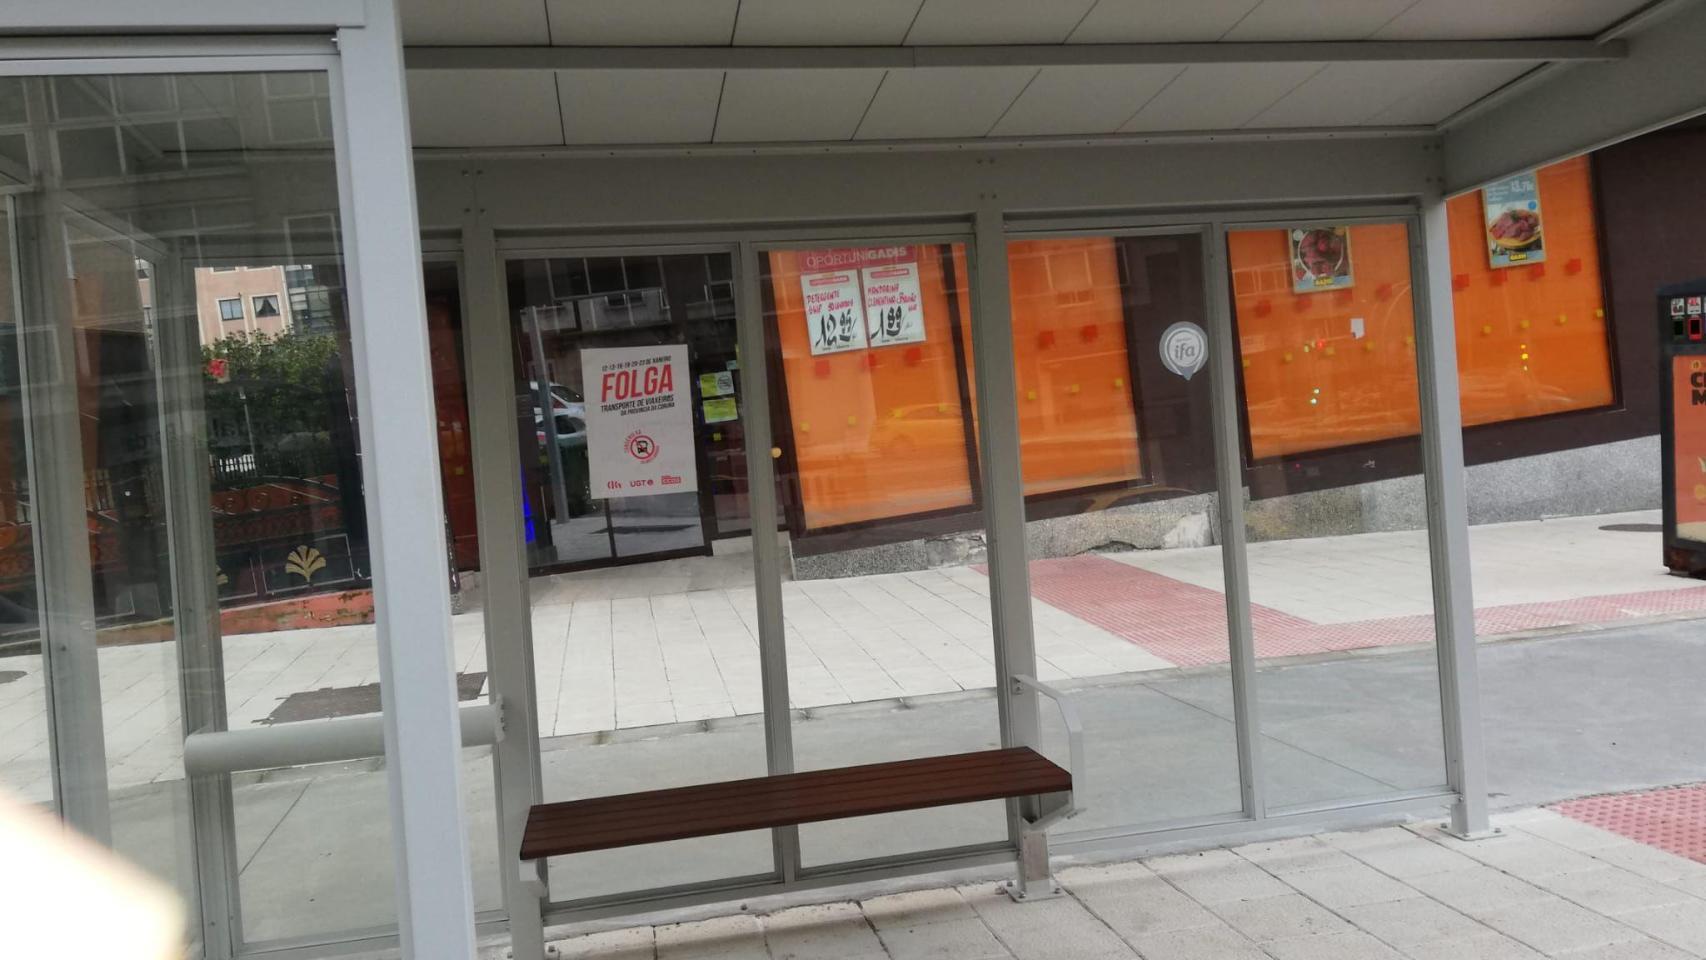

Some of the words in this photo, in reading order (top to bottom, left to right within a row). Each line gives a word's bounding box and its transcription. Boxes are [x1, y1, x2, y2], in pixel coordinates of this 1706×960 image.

[806, 248, 907, 268] OPORTUNIGADIS
[1174, 342, 1196, 361] ifa
[601, 363, 674, 403] FOLGA
[600, 399, 635, 413] TRANSPORTE
[636, 398, 645, 407] DE
[645, 394, 674, 405] VIAXEIROS
[630, 479, 646, 488] UGT
